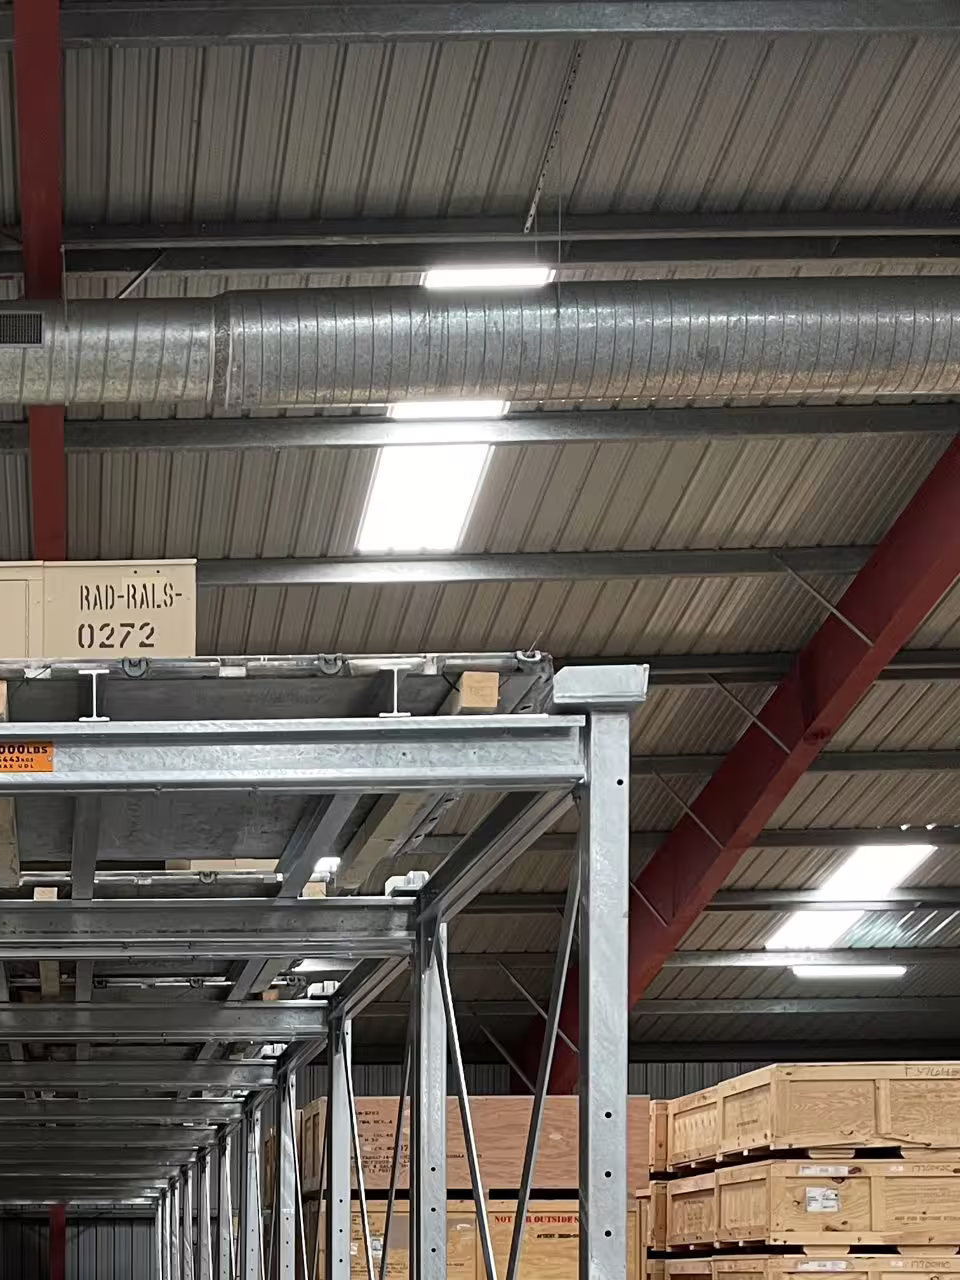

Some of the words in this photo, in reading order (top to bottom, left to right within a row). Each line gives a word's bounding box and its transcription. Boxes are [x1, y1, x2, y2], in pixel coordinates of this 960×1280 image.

[80, 583, 182, 611] RAD-RALS-
[78, 622, 155, 648] 0272
[494, 1215, 513, 1224] NOT
[534, 1215, 574, 1224] OUTSIDE
